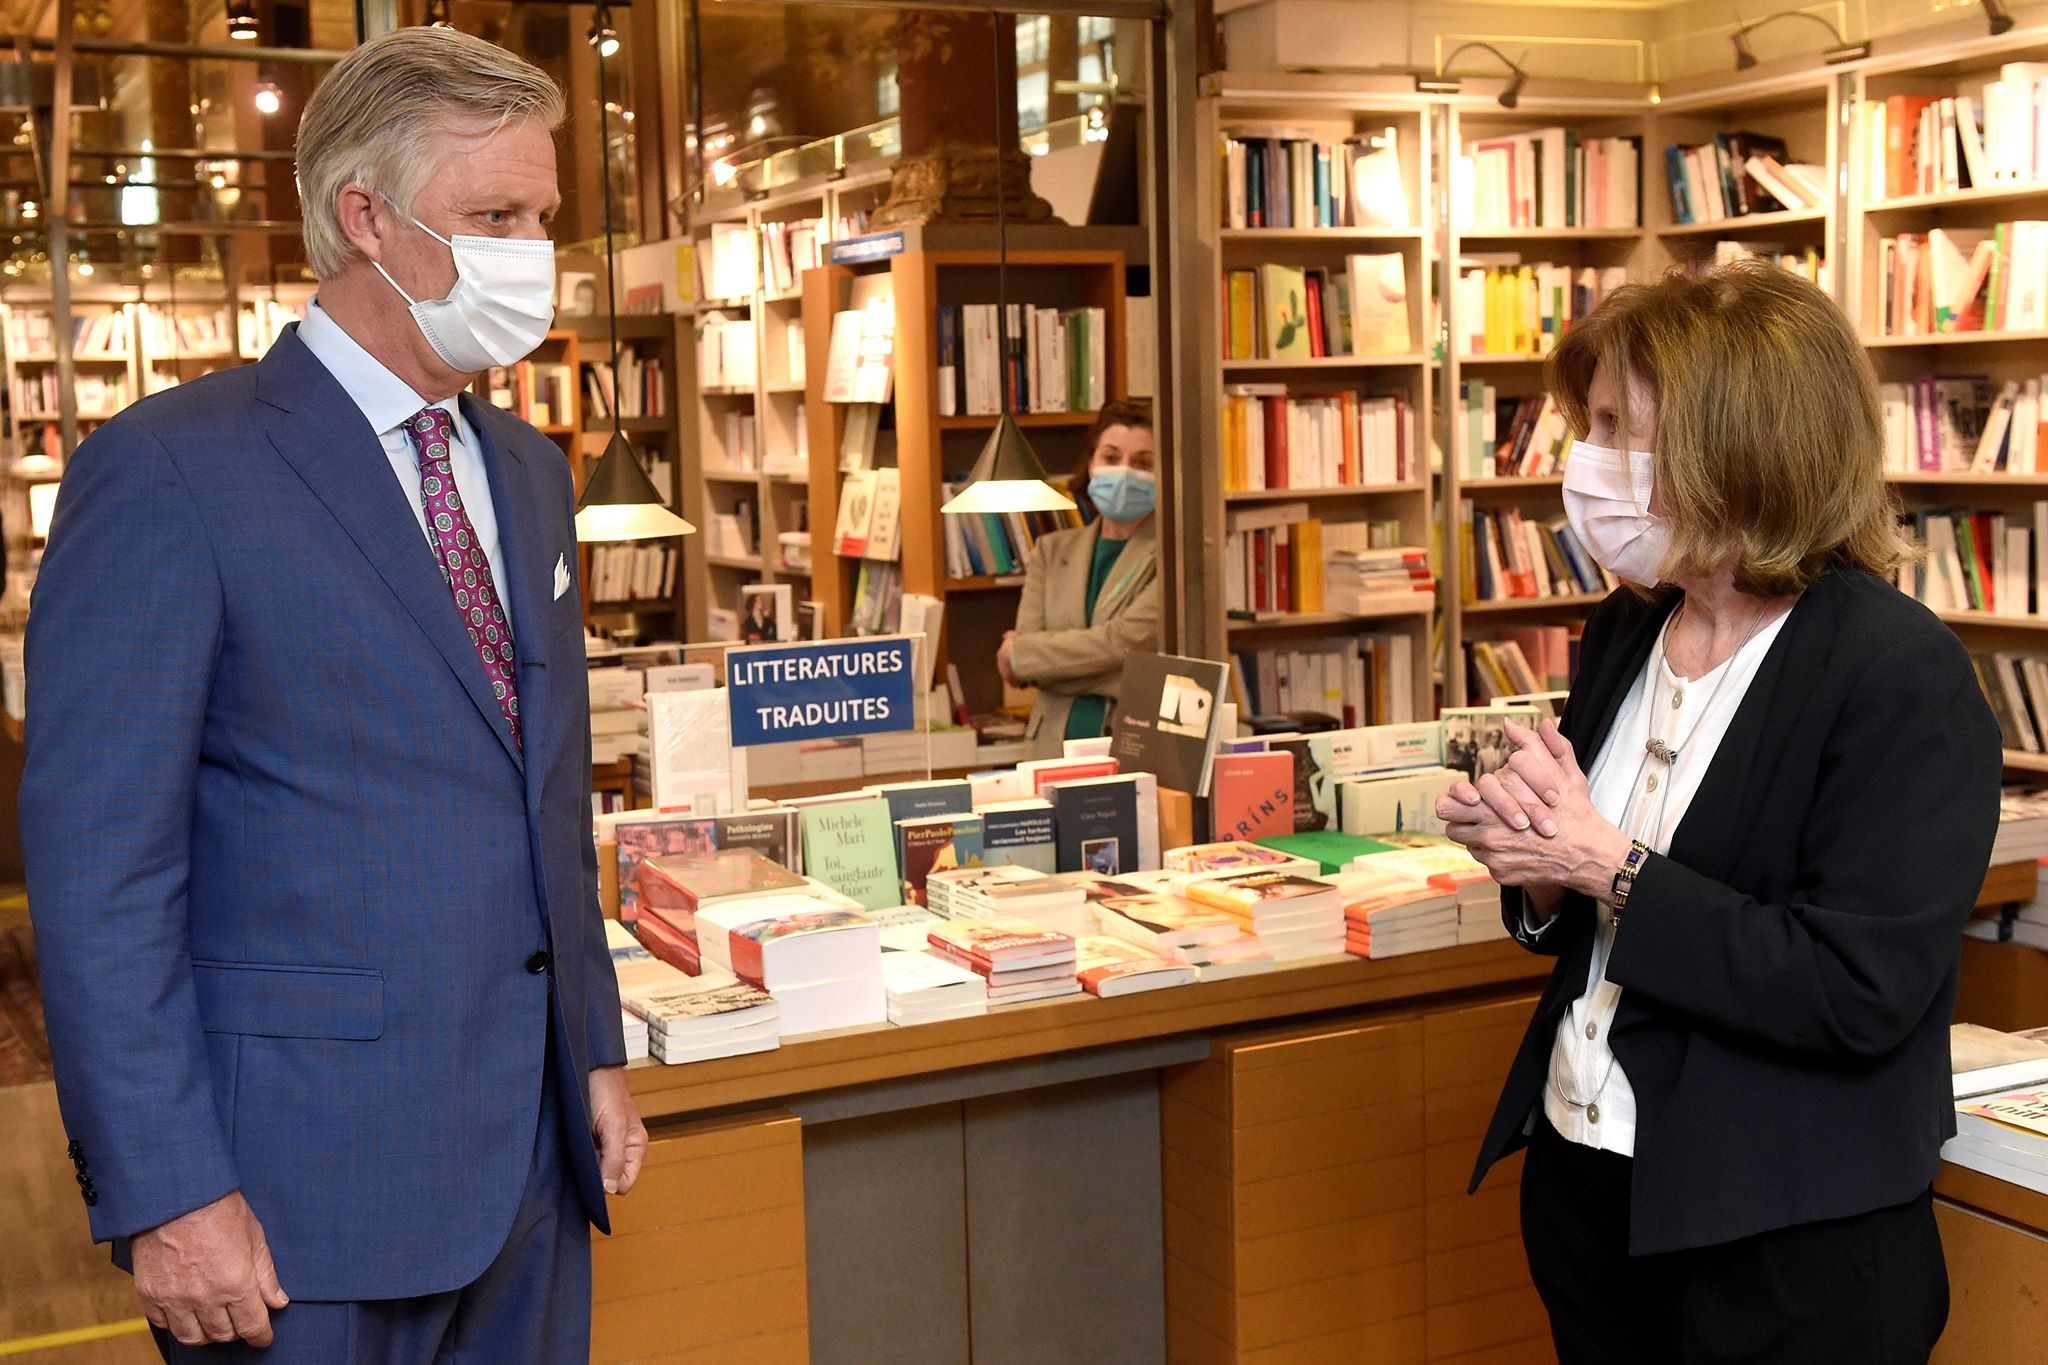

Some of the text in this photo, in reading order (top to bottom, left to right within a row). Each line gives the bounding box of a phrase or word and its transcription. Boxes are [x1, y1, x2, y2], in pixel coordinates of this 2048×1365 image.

[733, 649, 904, 686] LITTERATURES
[756, 696, 891, 730] TRADUITES
[819, 814, 864, 832] Michele
[836, 830, 866, 847] Mari
[830, 867, 885, 885] sanglante
